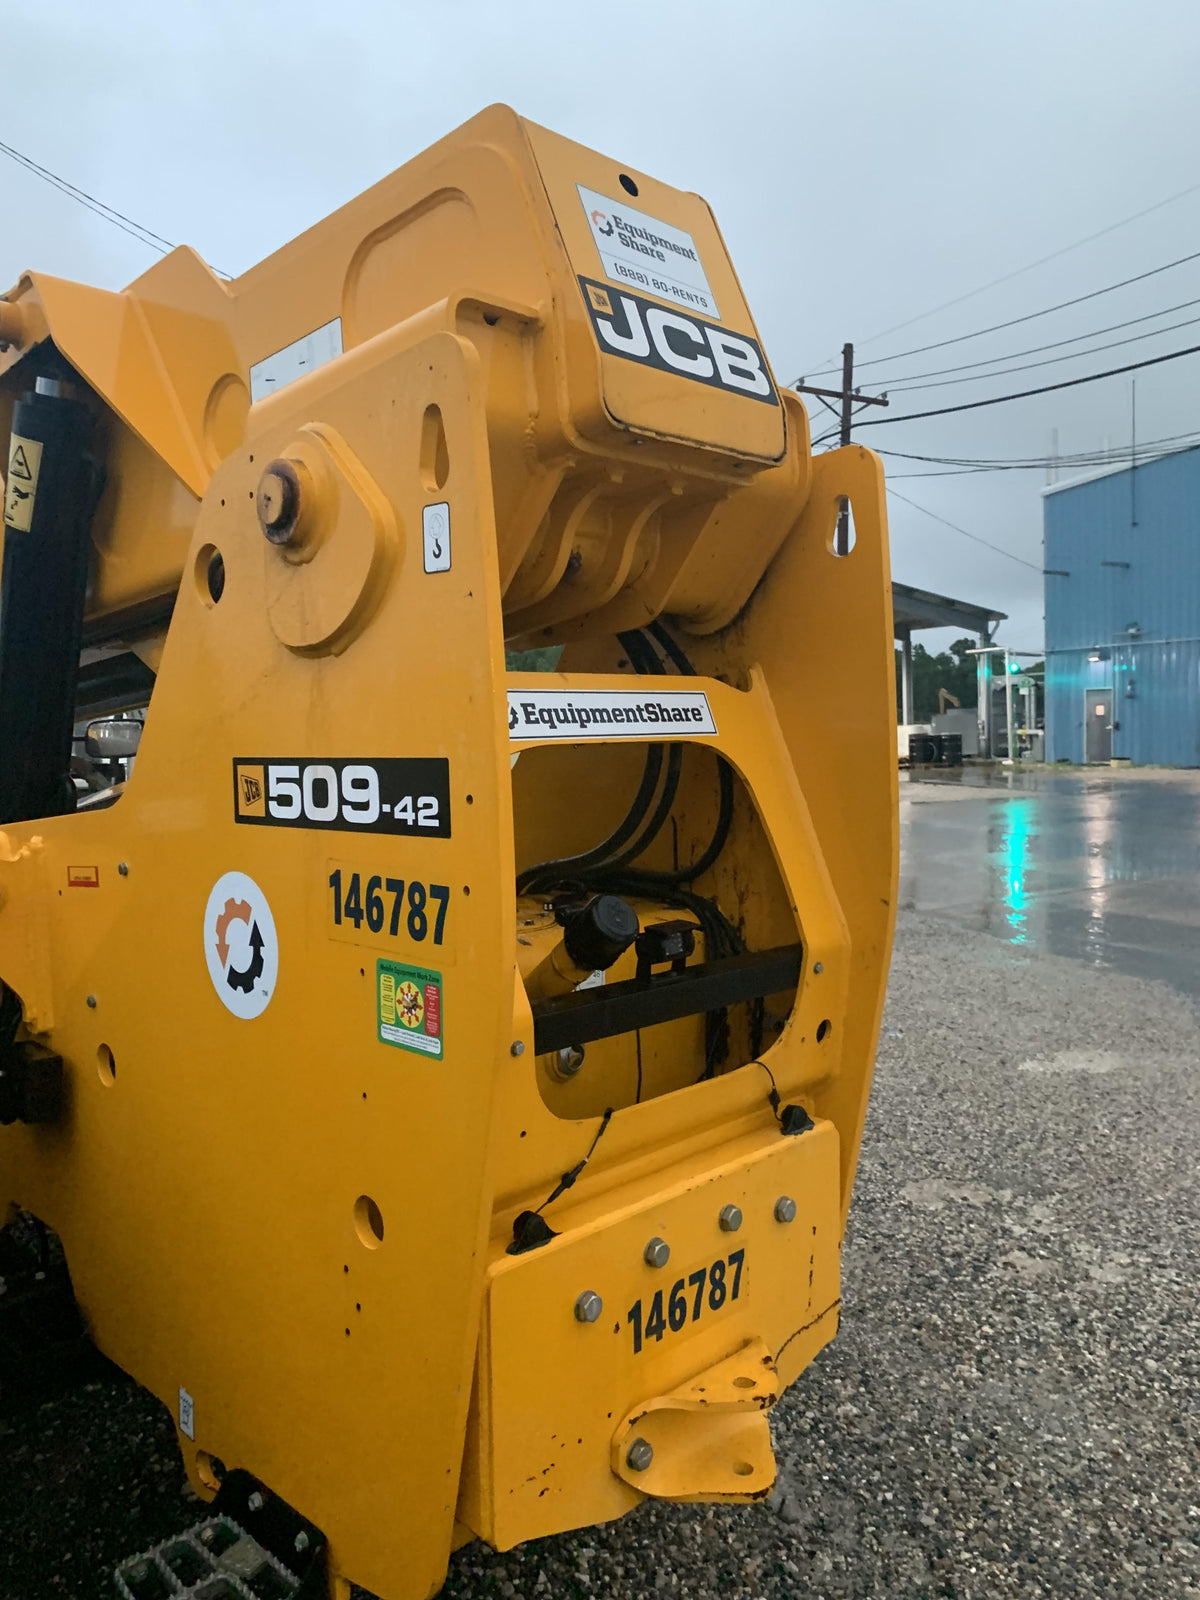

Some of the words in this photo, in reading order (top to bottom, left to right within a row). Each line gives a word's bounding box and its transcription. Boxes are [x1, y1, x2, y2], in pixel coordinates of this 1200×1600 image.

[612, 214, 697, 262] Equipment
[618, 231, 666, 262] Share
[614, 262, 649, 285] (888)
[652, 280, 708, 308] 80-RENTS
[596, 296, 770, 396] JCB
[520, 703, 703, 729] EquipmentShare
[243, 778, 262, 804] JCB
[328, 869, 450, 945] 146787
[627, 1248, 745, 1355] 146787
